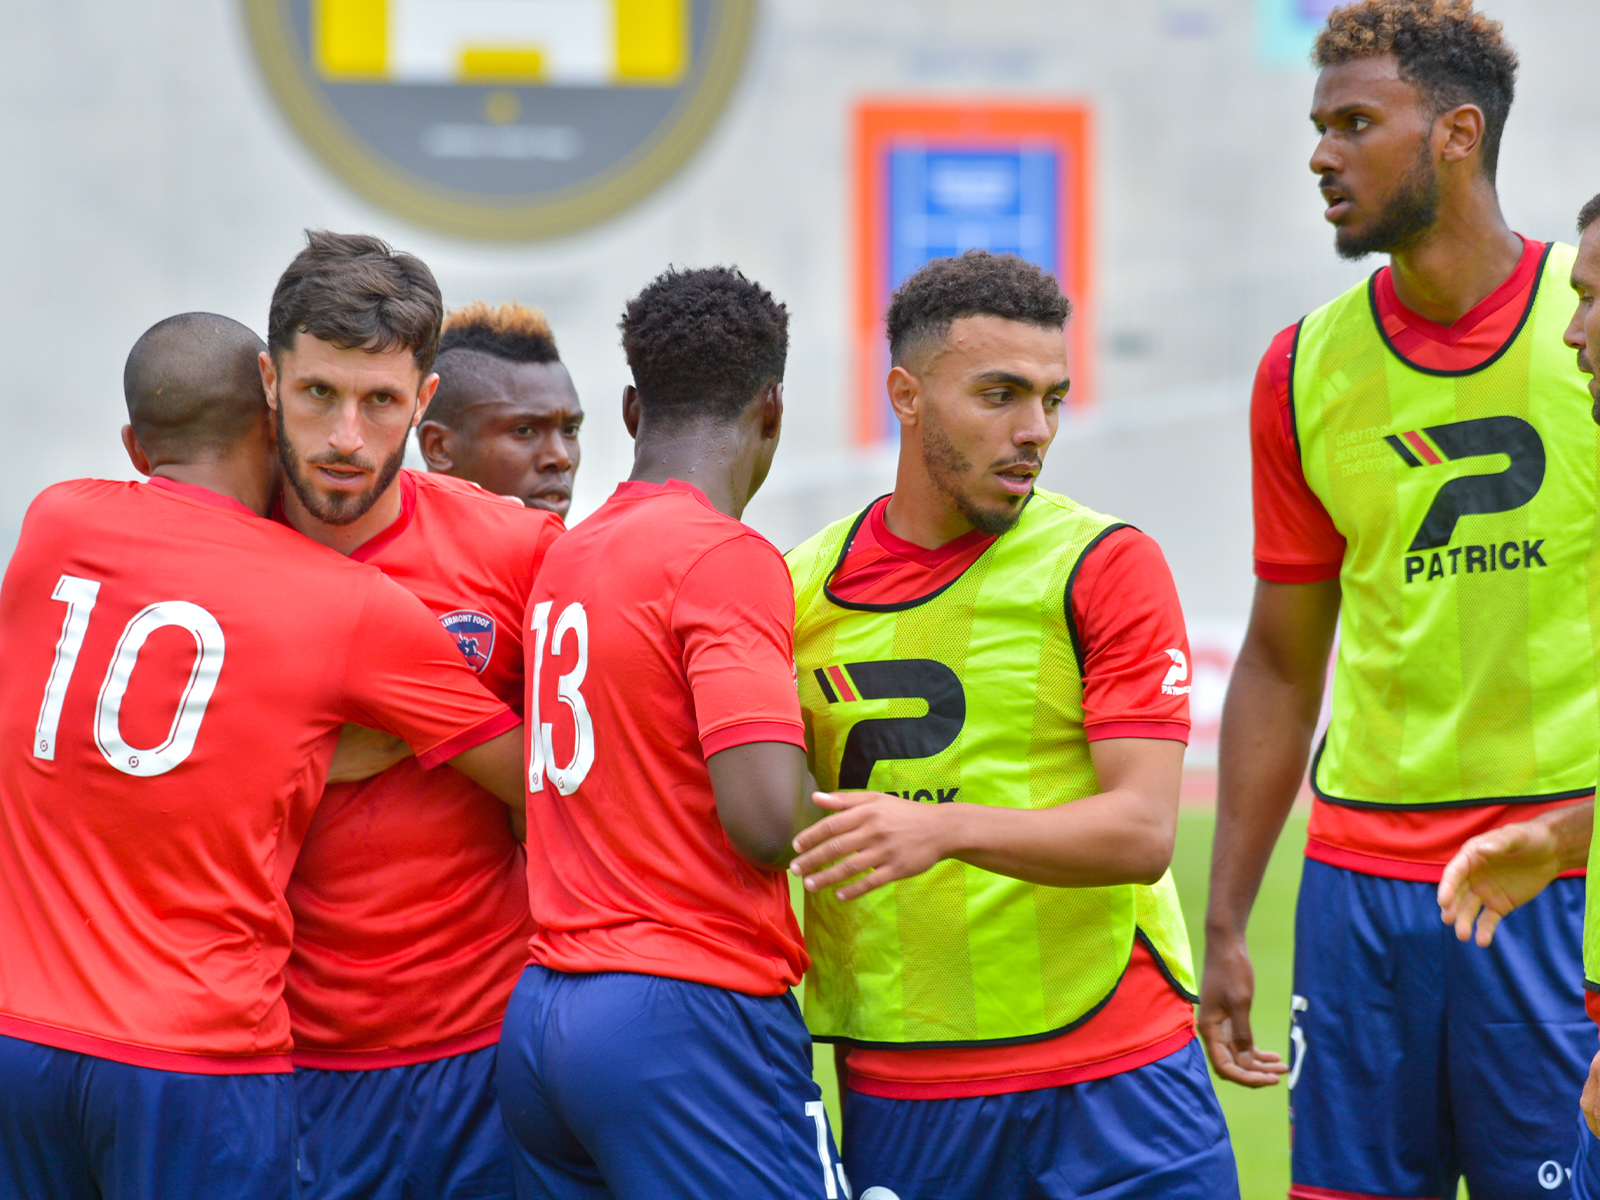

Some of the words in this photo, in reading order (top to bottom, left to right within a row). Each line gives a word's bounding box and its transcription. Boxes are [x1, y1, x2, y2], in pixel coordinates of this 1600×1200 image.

[1404, 539, 1548, 584] PATRICK
[440, 614, 472, 628] LERMONT
[472, 615, 490, 628] FOOT
[33, 574, 226, 777] 10
[528, 600, 595, 796] 13
[805, 1100, 853, 1200] 1
